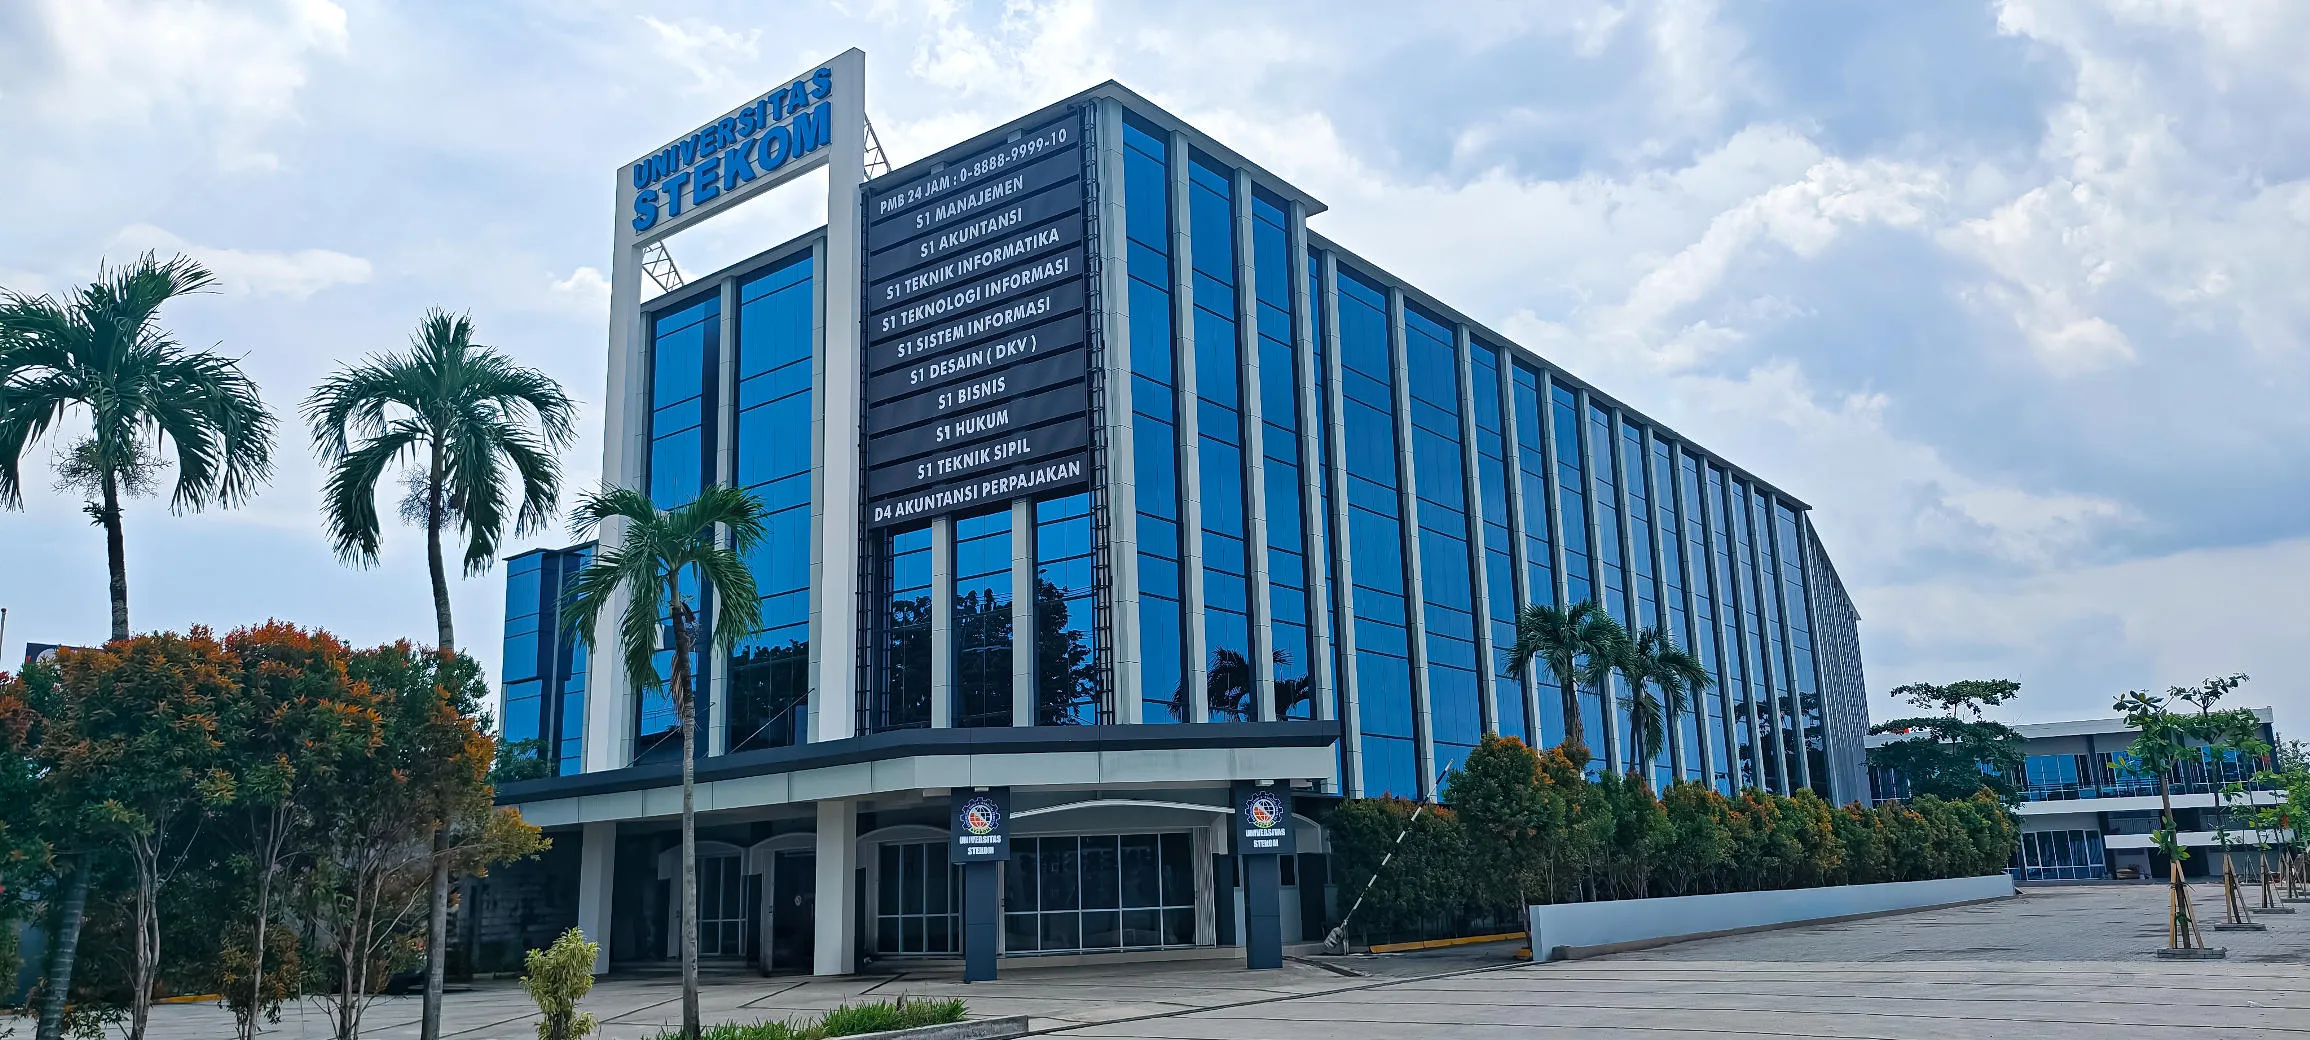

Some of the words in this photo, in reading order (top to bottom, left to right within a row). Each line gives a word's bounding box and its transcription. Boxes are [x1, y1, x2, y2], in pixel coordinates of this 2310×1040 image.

[634, 67, 832, 189] UNIVERSITAS
[632, 101, 831, 231] STEKOM
[880, 193, 905, 214] PMB
[908, 186, 922, 204] 24
[924, 176, 951, 197] JAM
[960, 128, 1067, 182] 0-8888-9999-10
[916, 211, 930, 229] S1
[935, 175, 1024, 222] MANAJEMEN
[920, 240, 935, 258] S1
[939, 207, 1022, 251] AKUNTANSI
[882, 315, 896, 332] S1
[900, 286, 981, 326] TEKNOLOGI
[985, 257, 1069, 298] INFORMASI
[886, 283, 900, 300] S1
[904, 263, 954, 294] TEKNIK
[958, 228, 1060, 276] INFORMATIKA
[897, 341, 912, 358] S1
[916, 324, 964, 352] SISTEM
[968, 296, 1050, 336] INFORMASI
[910, 368, 924, 385] S1
[929, 350, 983, 379] DESAIN
[938, 392, 952, 410] S1
[958, 376, 1006, 404] BISNIS
[936, 426, 951, 442] S1
[955, 409, 1009, 438] HUKUM
[917, 462, 932, 480] S1
[937, 447, 991, 475] TEKNIK
[994, 438, 1031, 462] SIPIL
[874, 503, 891, 522] D4
[895, 483, 978, 518] AKUNTANSI
[982, 460, 1080, 498] PERPAJAKAN
